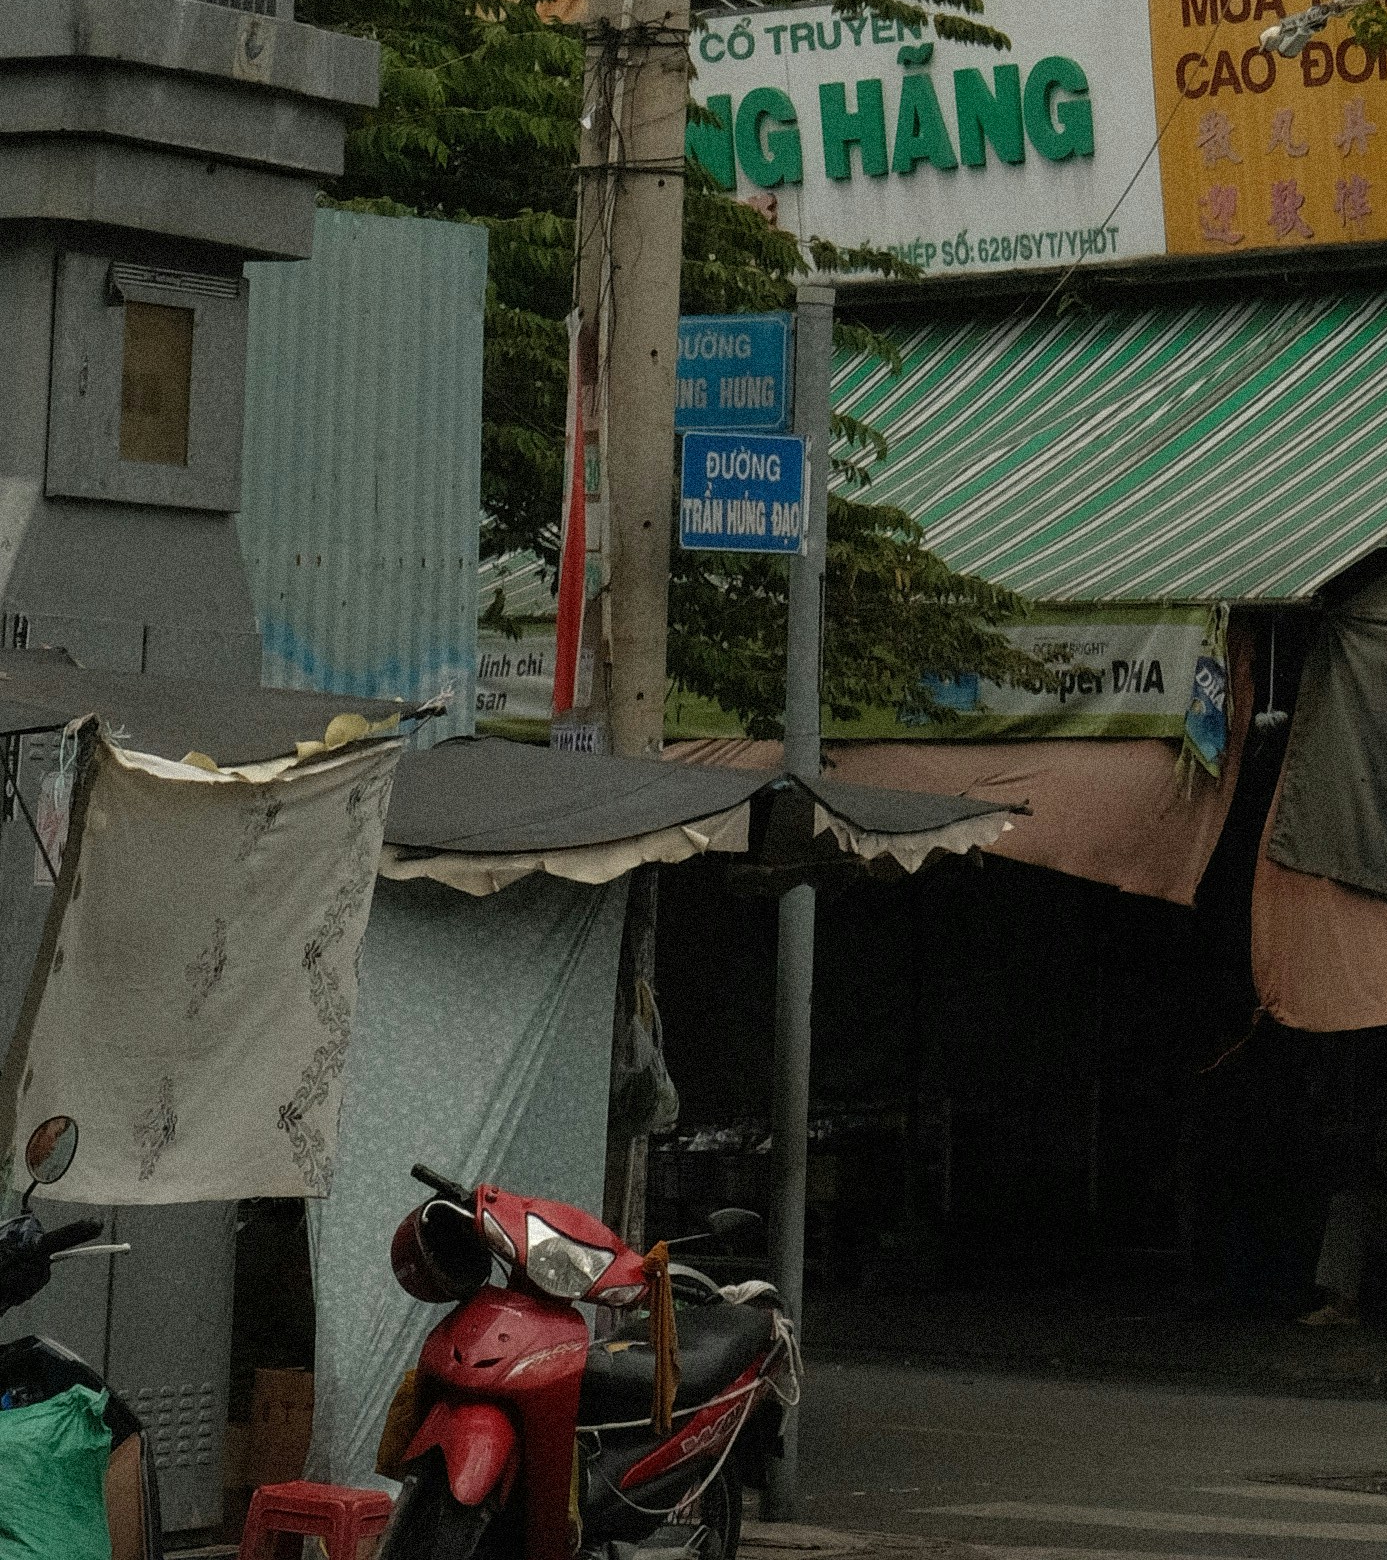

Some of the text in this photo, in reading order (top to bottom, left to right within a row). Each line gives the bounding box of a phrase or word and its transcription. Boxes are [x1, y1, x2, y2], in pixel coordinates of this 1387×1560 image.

[699, 16, 755, 63] CỔ
[1175, 46, 1277, 99] CAO
[686, 42, 1095, 193] NG HÃNG
[942, 229, 975, 266] SỐ:
[720, 371, 775, 410] HƯNG
[706, 445, 782, 482] ĐƯỜNG
[683, 480, 800, 546] TRẦN HƯNG ĐẠO
[479, 652, 544, 680] linh chi
[1112, 659, 1165, 695] DHA
[476, 690, 508, 711] san
